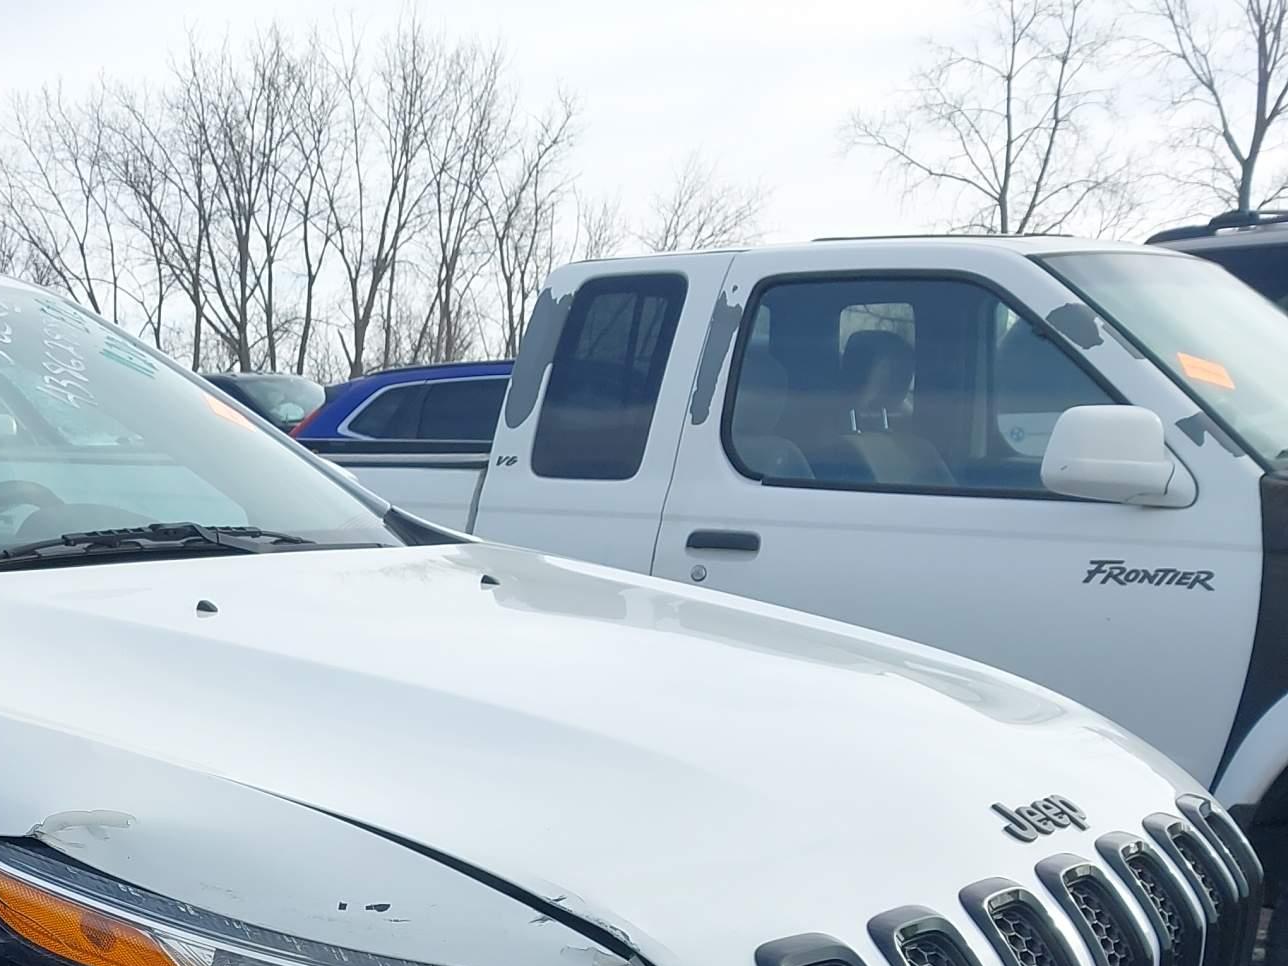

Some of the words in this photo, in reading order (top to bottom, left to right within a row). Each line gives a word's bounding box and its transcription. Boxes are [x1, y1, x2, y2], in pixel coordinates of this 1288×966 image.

[495, 455, 518, 467] V6
[1082, 559, 1215, 592] FRONTIER
[989, 794, 1090, 843] Jeep
